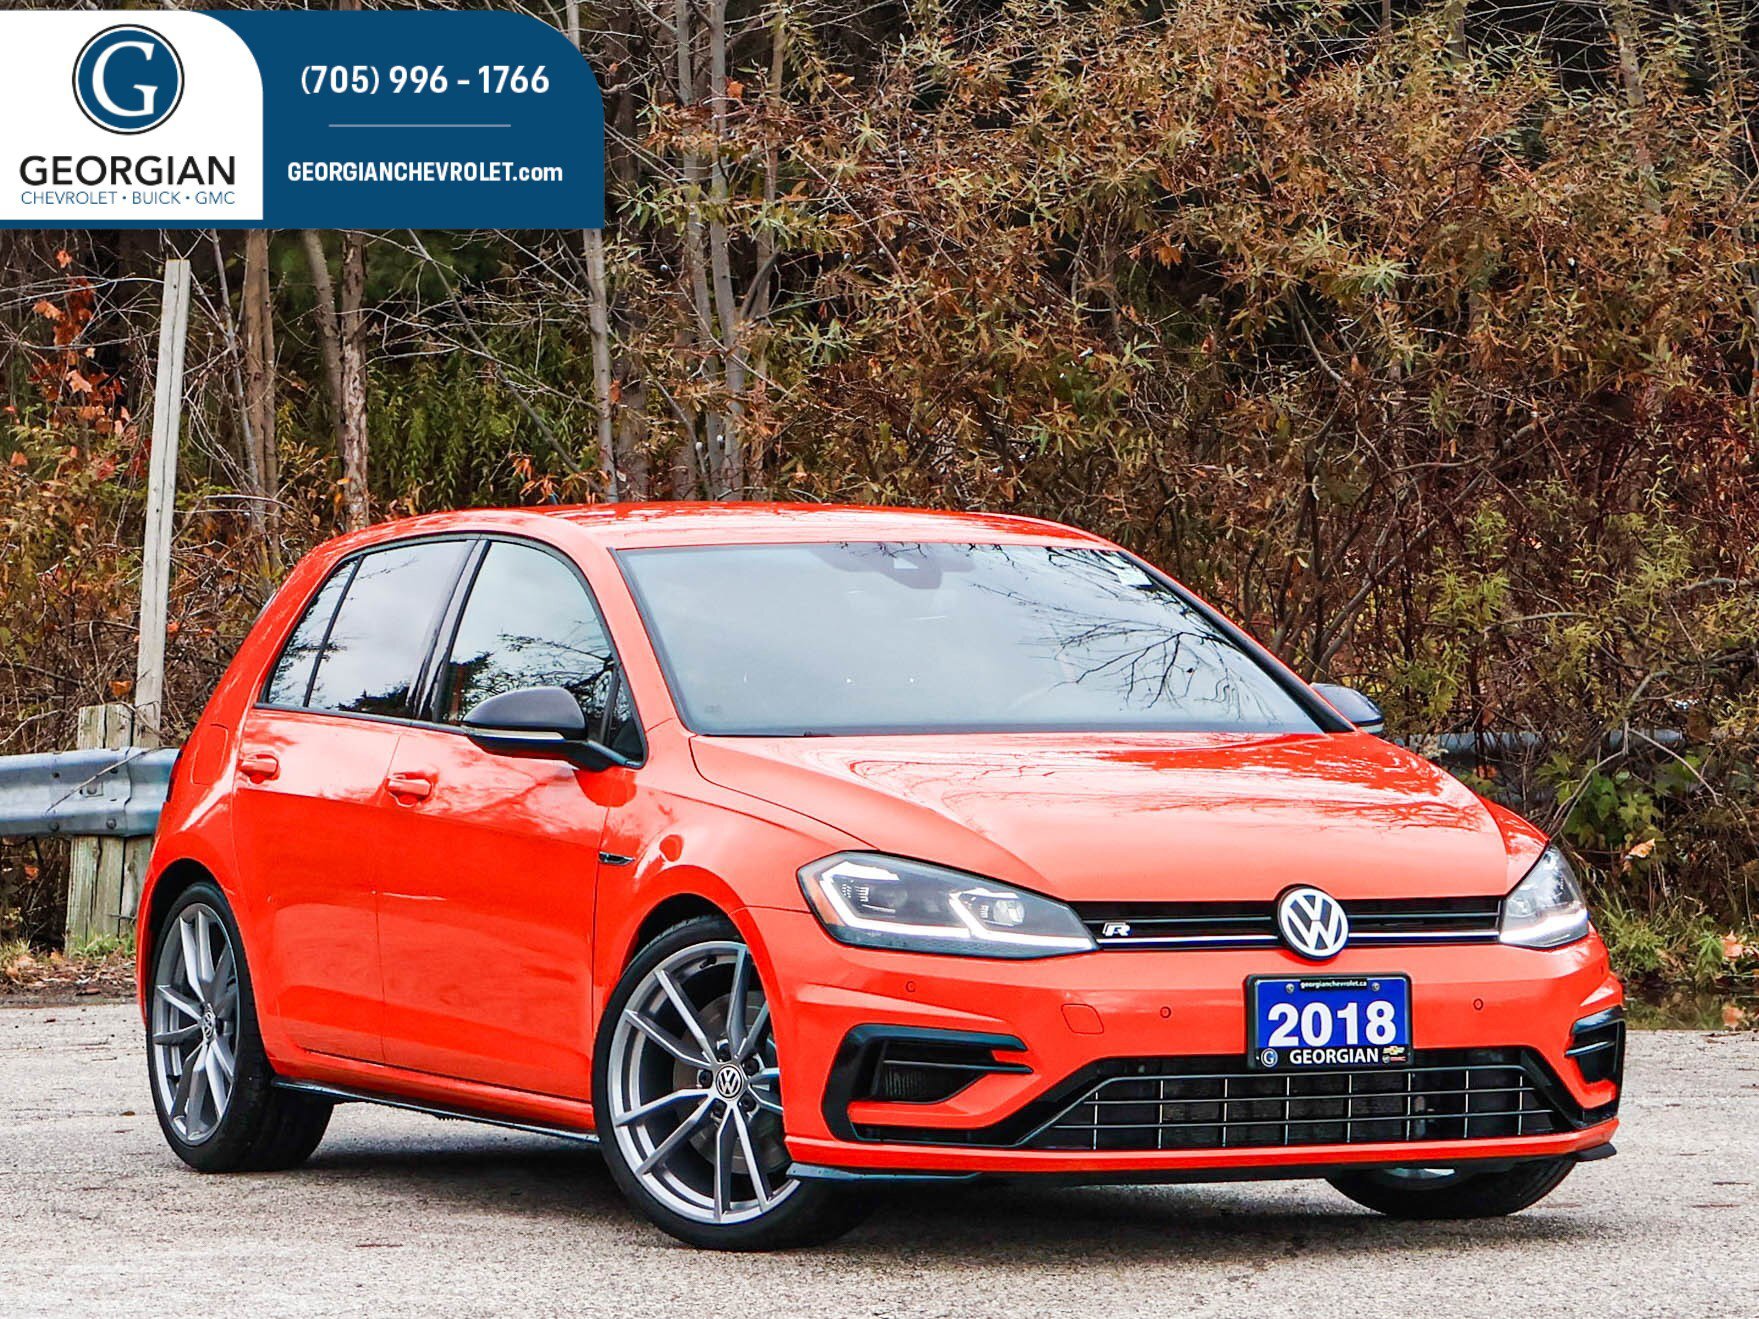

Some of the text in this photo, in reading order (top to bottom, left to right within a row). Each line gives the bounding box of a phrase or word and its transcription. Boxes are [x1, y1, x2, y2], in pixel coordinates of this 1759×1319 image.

[1102, 922, 1131, 936] R
[1300, 980, 1367, 989] georgianchevrolet.ca
[1267, 1000, 1397, 1048] 2018
[1289, 1047, 1379, 1065] GEORGIAN
